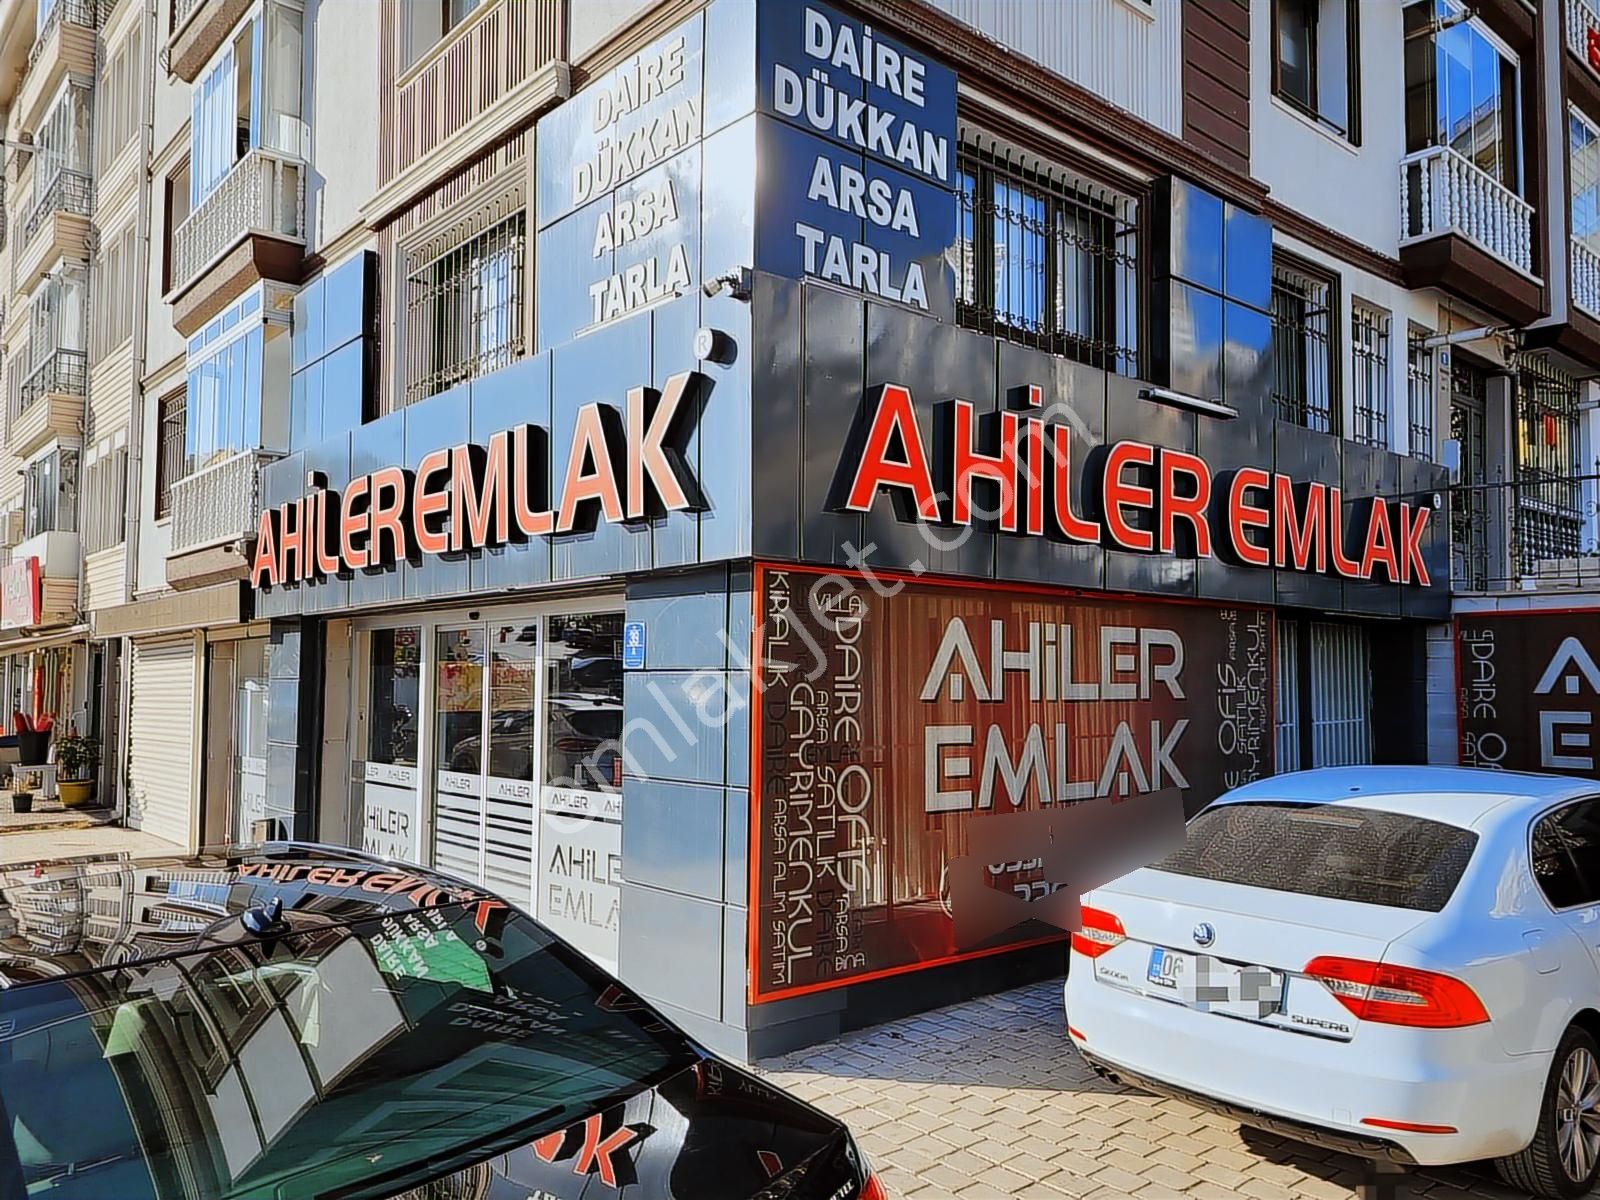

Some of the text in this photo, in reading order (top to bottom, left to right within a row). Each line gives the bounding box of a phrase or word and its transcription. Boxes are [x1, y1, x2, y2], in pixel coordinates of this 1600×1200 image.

[592, 36, 686, 134] DAİRE
[803, 6, 926, 108] DAİRE
[572, 97, 703, 207] DÜKKAN
[773, 63, 948, 181] DÜKKAN
[592, 179, 679, 258] ARSA
[807, 156, 920, 238] ARSA
[588, 244, 692, 323] TARLA
[796, 222, 930, 310] TARLA
[412, 370, 695, 554] EMLAK
[845, 383, 1433, 587] AHİLER EMLAK
[816, 690, 829, 744] ARSA
[924, 718, 1191, 813] EMLAK
[366, 804, 409, 838] HiLER
[549, 843, 622, 887] AHiLE
[816, 765, 837, 879] SATILIK
[549, 883, 621, 932] EMLA
[771, 798, 788, 985] ARSA ALIM SATIM
[836, 896, 849, 954] ARSA
[1291, 1014, 1350, 1033] SUPERB
